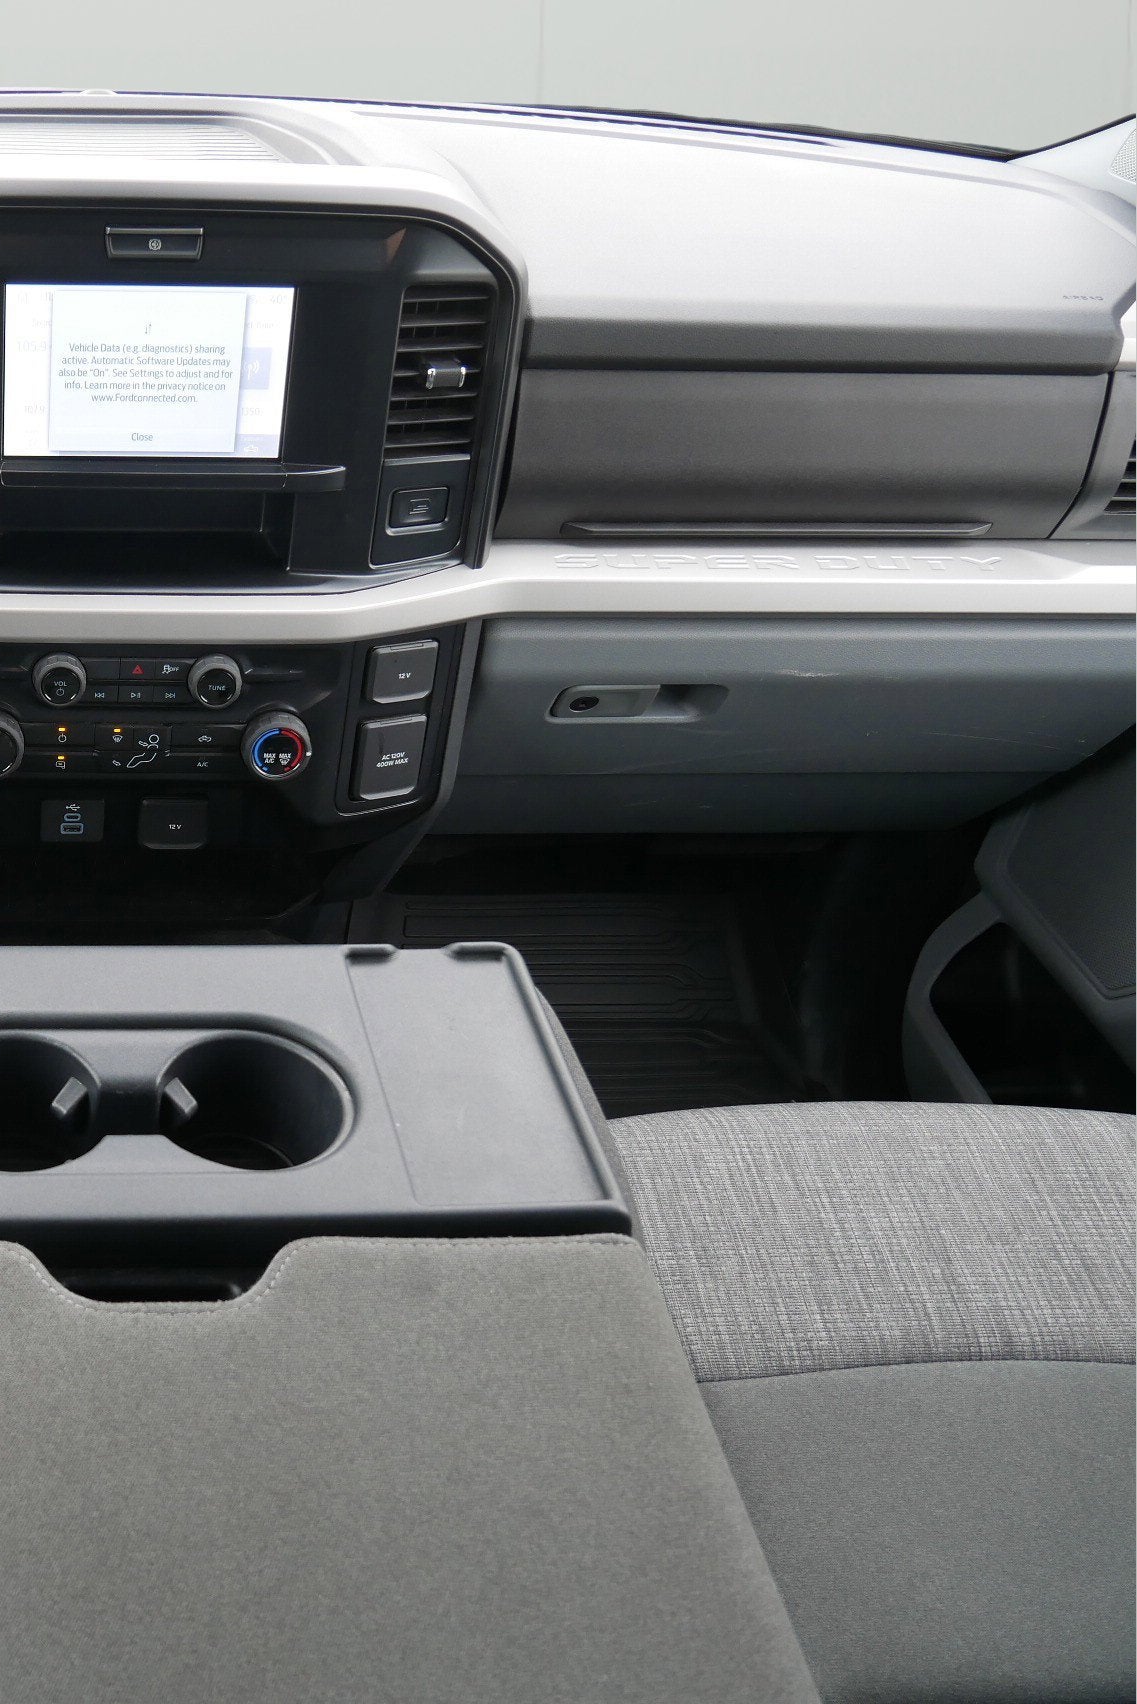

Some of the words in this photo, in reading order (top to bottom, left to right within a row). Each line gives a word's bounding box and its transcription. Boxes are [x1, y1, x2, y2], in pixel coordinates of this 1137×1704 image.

[69, 342, 98, 352] Vehicle
[101, 343, 120, 352] Data
[141, 344, 192, 355] diagnostics)
[195, 345, 225, 355] sharing
[62, 356, 88, 365] active.
[91, 356, 134, 365] Automatic
[137, 357, 175, 366] Software
[177, 357, 211, 367] Updates
[213, 359, 231, 367] may
[58, 368, 76, 377] also
[77, 368, 88, 377] be
[112, 369, 128, 378] See
[130, 369, 164, 379] Settings
[165, 370, 175, 378] to
[176, 370, 201, 380] adjust
[203, 370, 219, 379] and
[221, 370, 233, 379] for
[84, 381, 108, 390] Learn
[132, 381, 140, 390] in
[142, 382, 155, 390] the
[158, 382, 186, 391] privacy
[188, 382, 213, 390] notice
[91, 393, 198, 403] www.Fordconnected.com.
[131, 432, 153, 442] Close
[553, 553, 801, 571] SUPER
[812, 554, 1004, 571] DUTY
[394, 757, 409, 765] MAX
